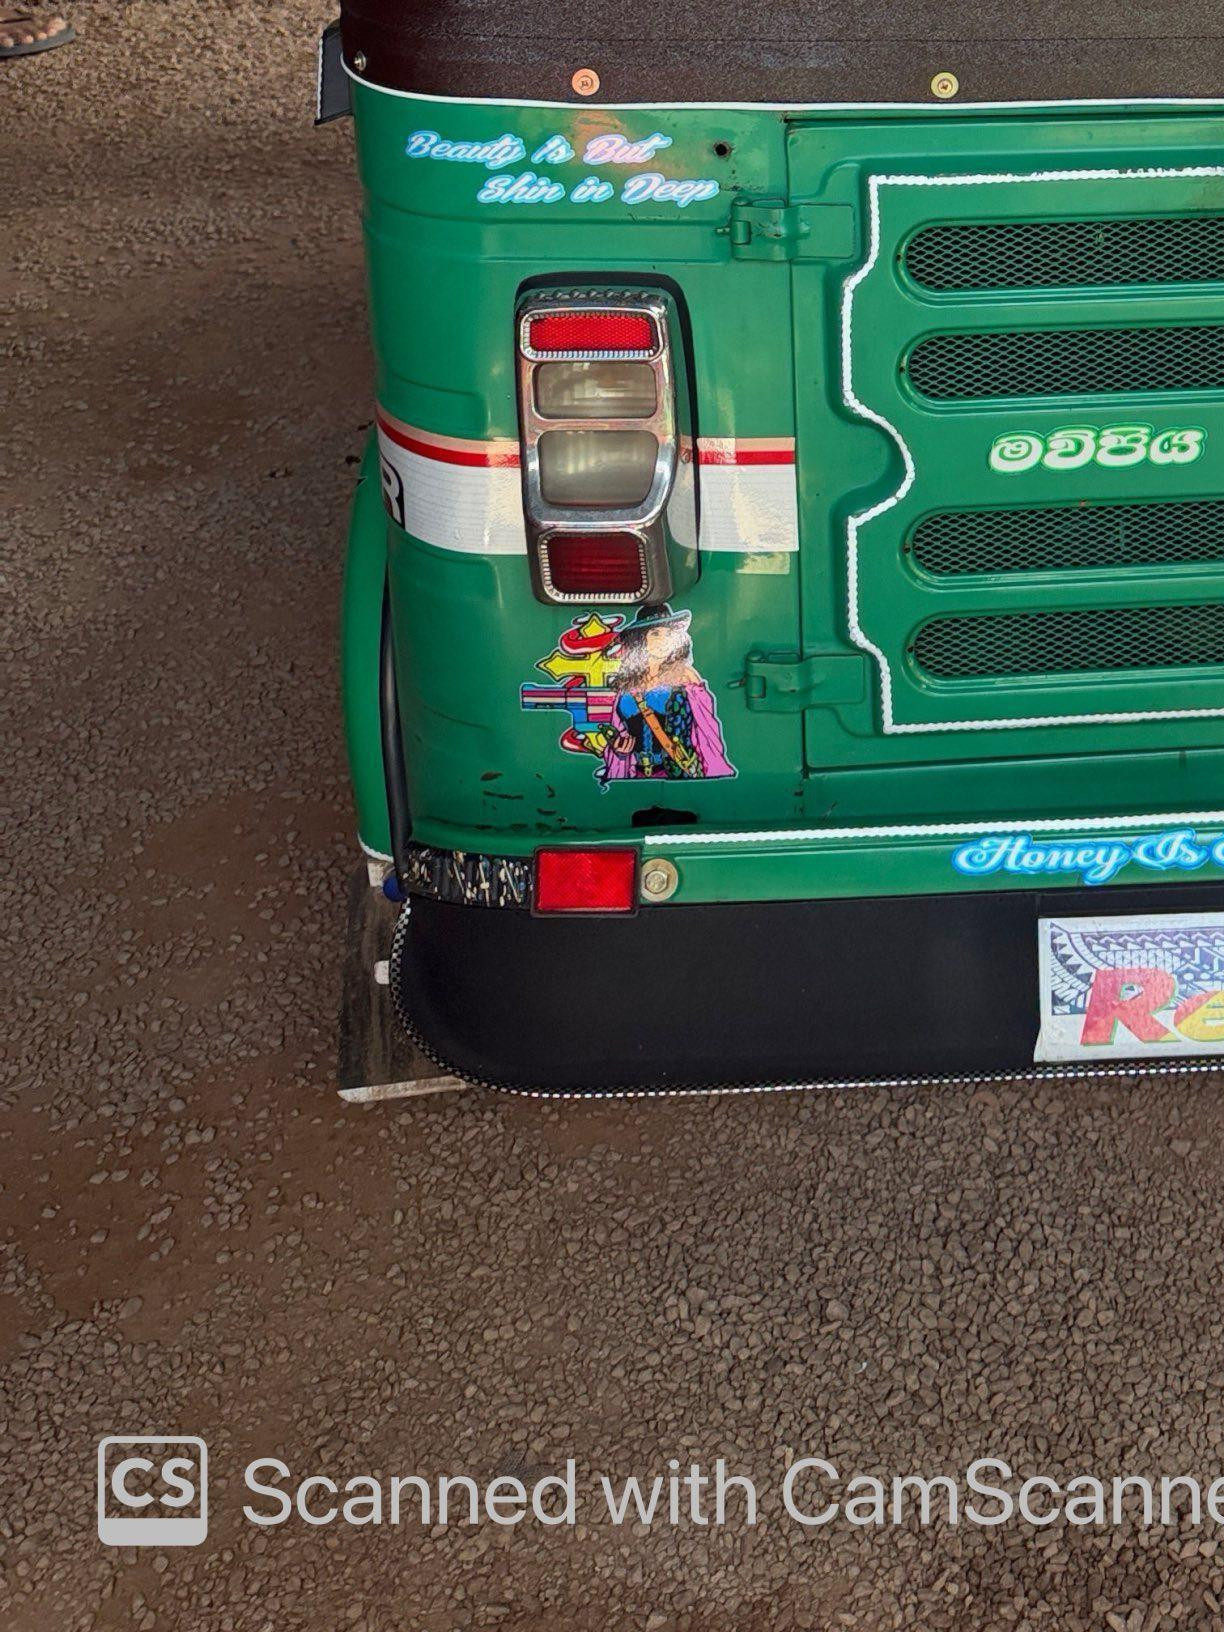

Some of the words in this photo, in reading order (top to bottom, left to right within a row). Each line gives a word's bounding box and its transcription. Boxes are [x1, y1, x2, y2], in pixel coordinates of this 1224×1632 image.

[406, 130, 526, 170] Beauty
[582, 132, 673, 166] But
[570, 176, 614, 203] in
[621, 172, 720, 208] Deep
[952, 831, 1132, 887] Honey
[1132, 827, 1209, 870] Is
